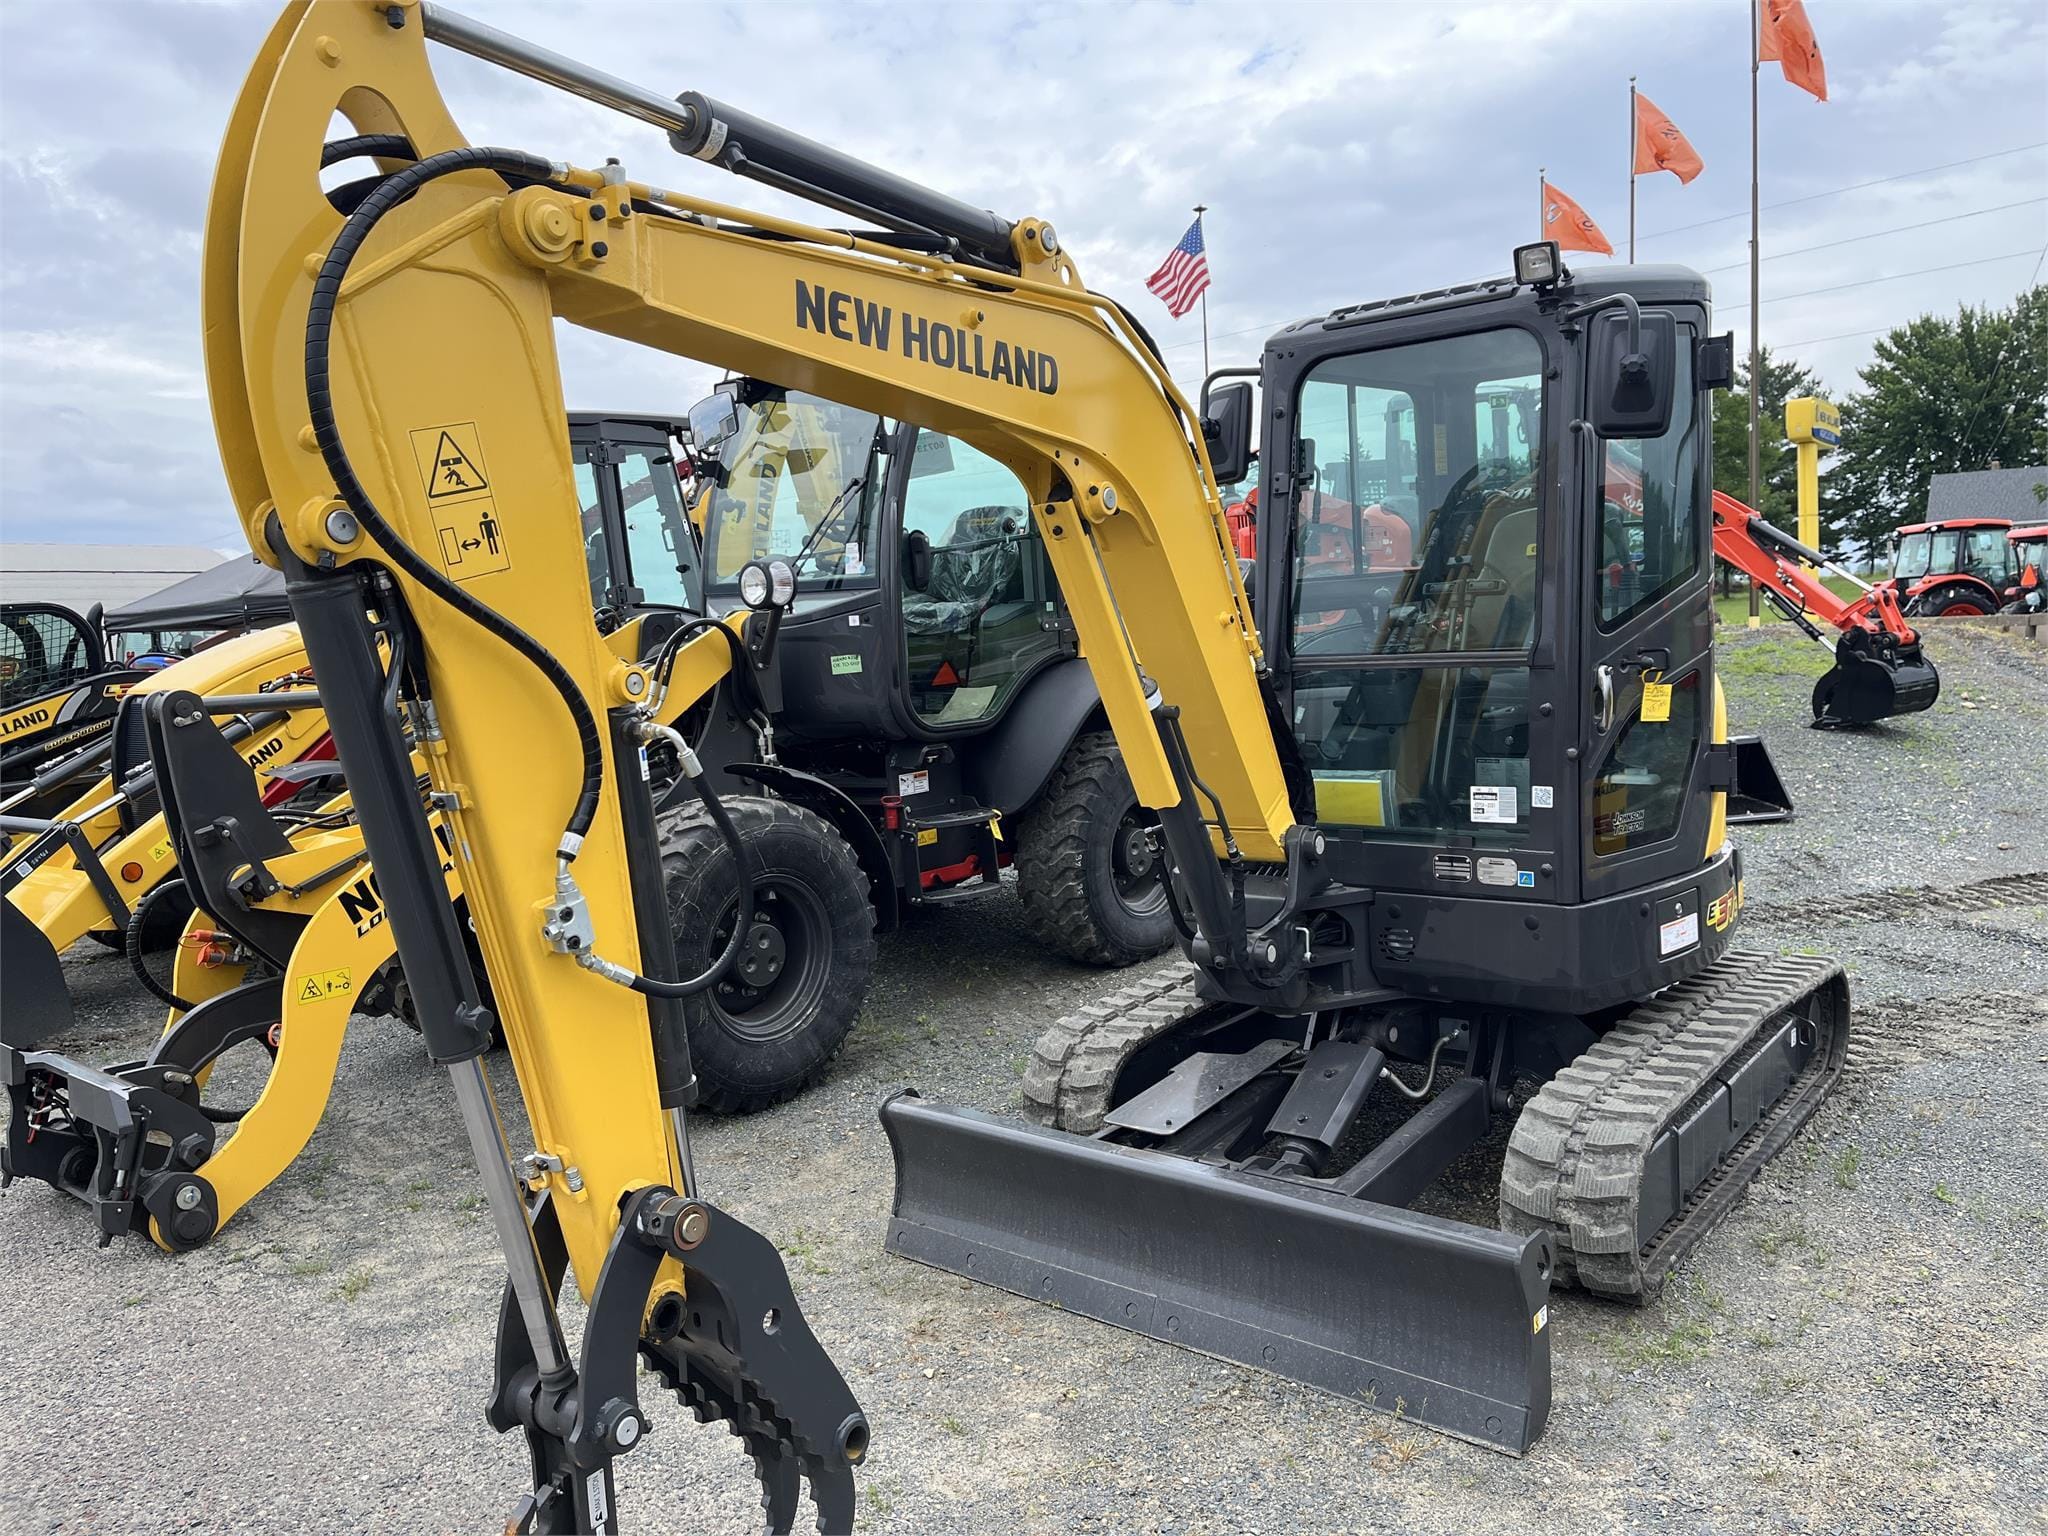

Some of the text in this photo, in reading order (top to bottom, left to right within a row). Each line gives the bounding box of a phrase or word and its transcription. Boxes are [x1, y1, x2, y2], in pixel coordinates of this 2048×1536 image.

[795, 278, 1059, 396] NEW HOLLAND
[1613, 809, 1646, 826] JOHNSON
[1613, 820, 1645, 836] TRACTOR
